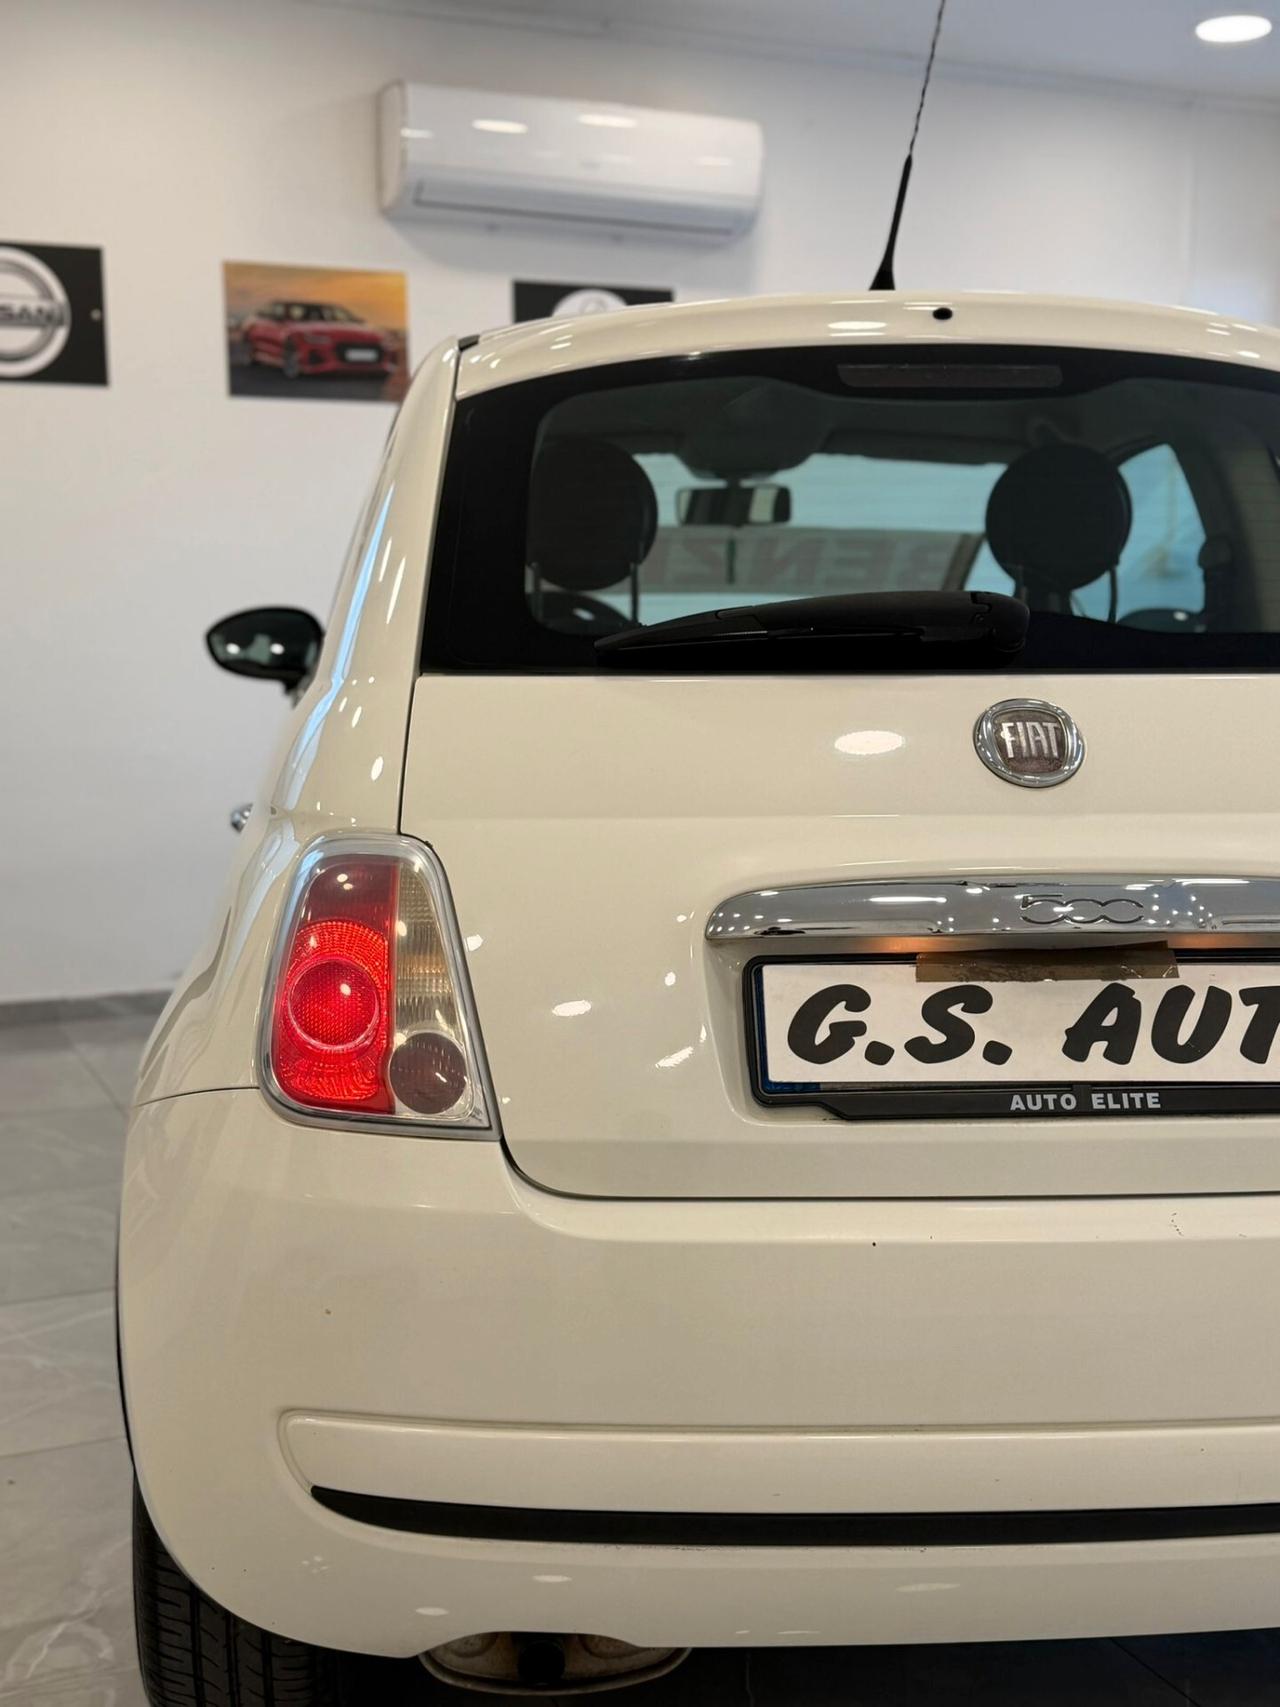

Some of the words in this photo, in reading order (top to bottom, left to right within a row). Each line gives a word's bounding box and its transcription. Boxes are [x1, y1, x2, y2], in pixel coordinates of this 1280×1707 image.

[1000, 721, 1060, 758] FIAT
[1019, 893, 1145, 925] 500
[787, 983, 1013, 1066] G.S.
[1010, 1093, 1077, 1111] AUTO
[1091, 1092, 1161, 1110] ELITE
